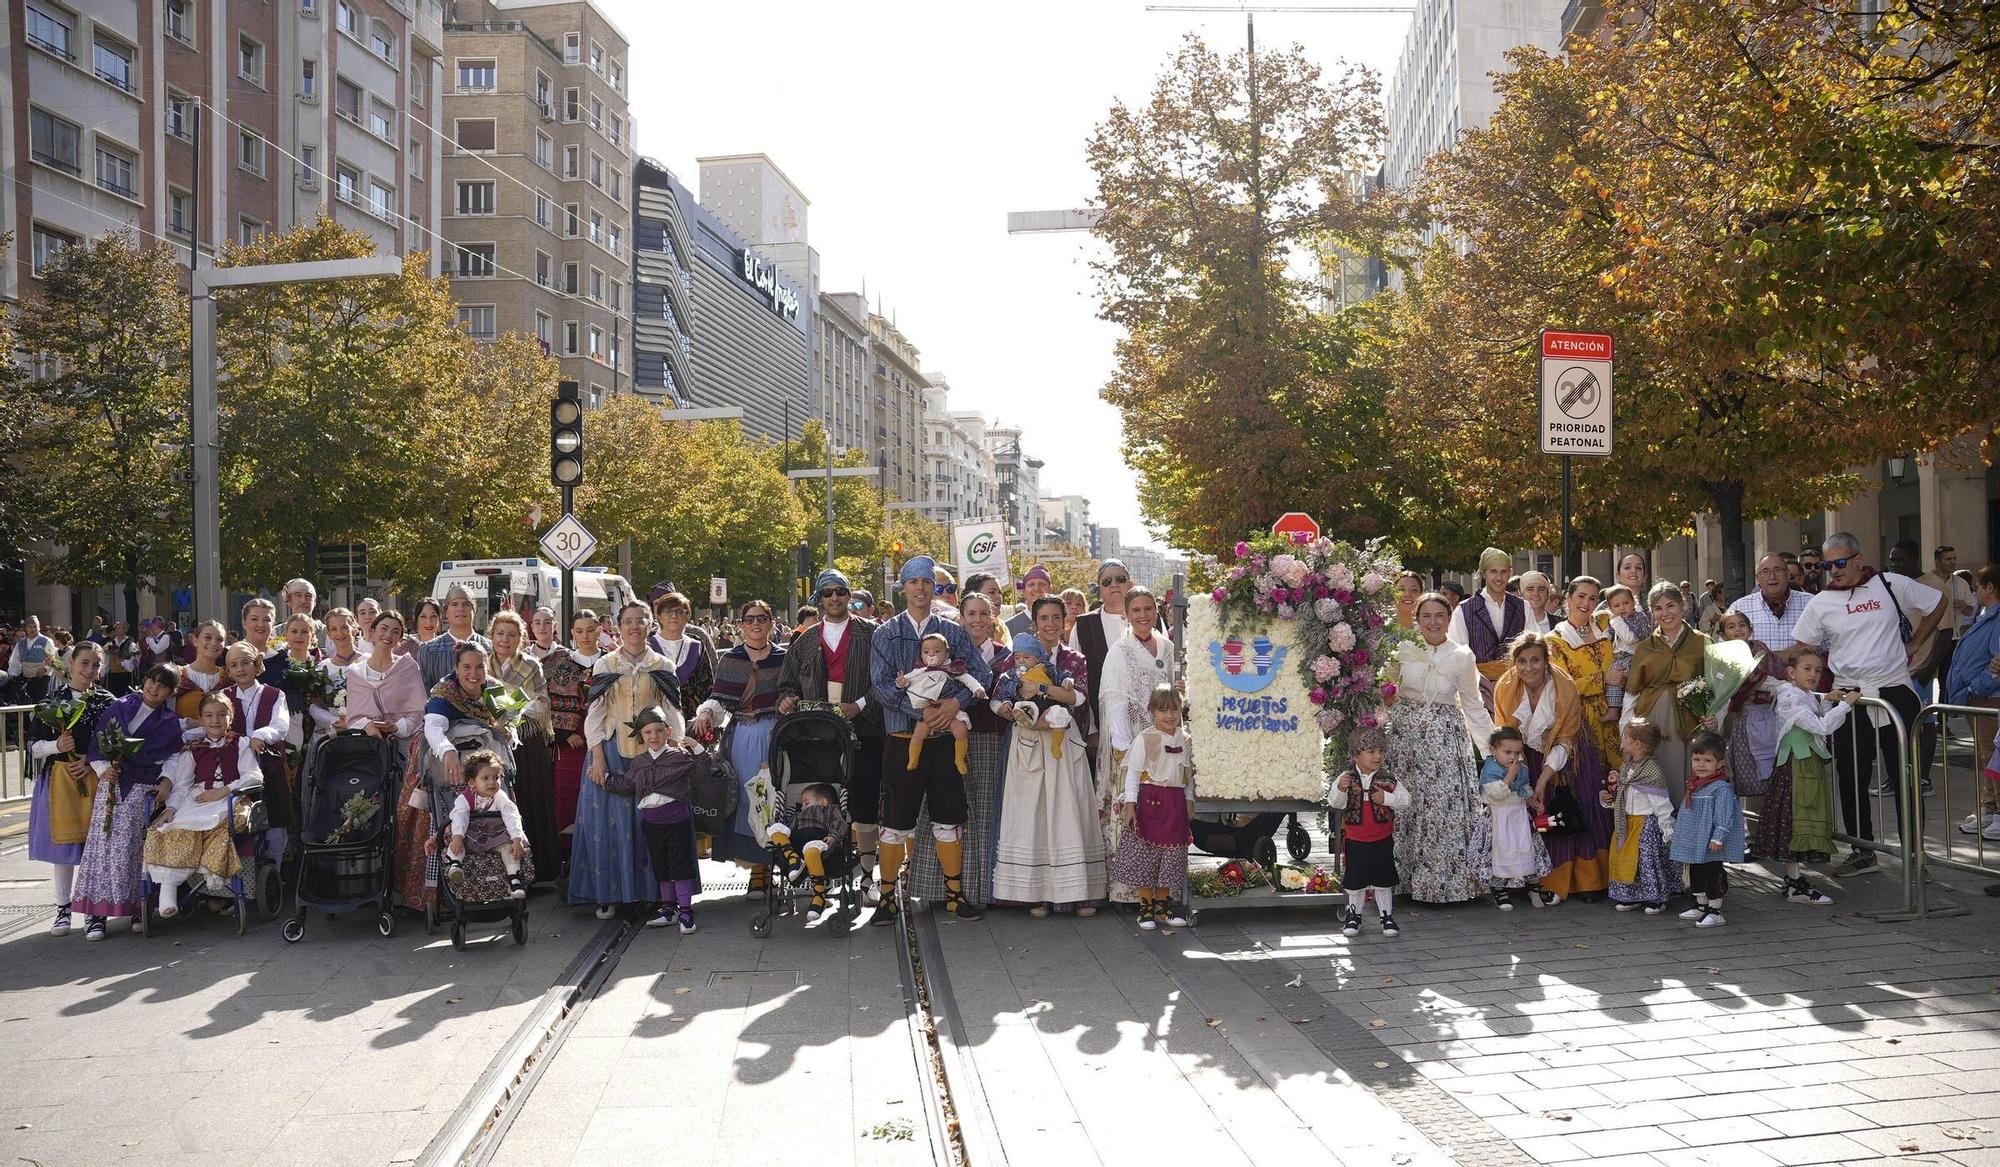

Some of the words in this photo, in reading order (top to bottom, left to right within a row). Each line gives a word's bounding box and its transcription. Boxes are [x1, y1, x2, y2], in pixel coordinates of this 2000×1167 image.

[744, 248, 754, 282] El
[754, 258, 775, 297] Corte
[774, 262, 800, 318] Inglés
[1550, 340, 1605, 352] ATENCIÓN
[1549, 422, 1606, 434] PRIORIDAD
[1550, 437, 1605, 448] PEATONAL
[556, 531, 581, 551] 30
[1278, 530, 1315, 542] TP
[972, 540, 998, 554] CSIF
